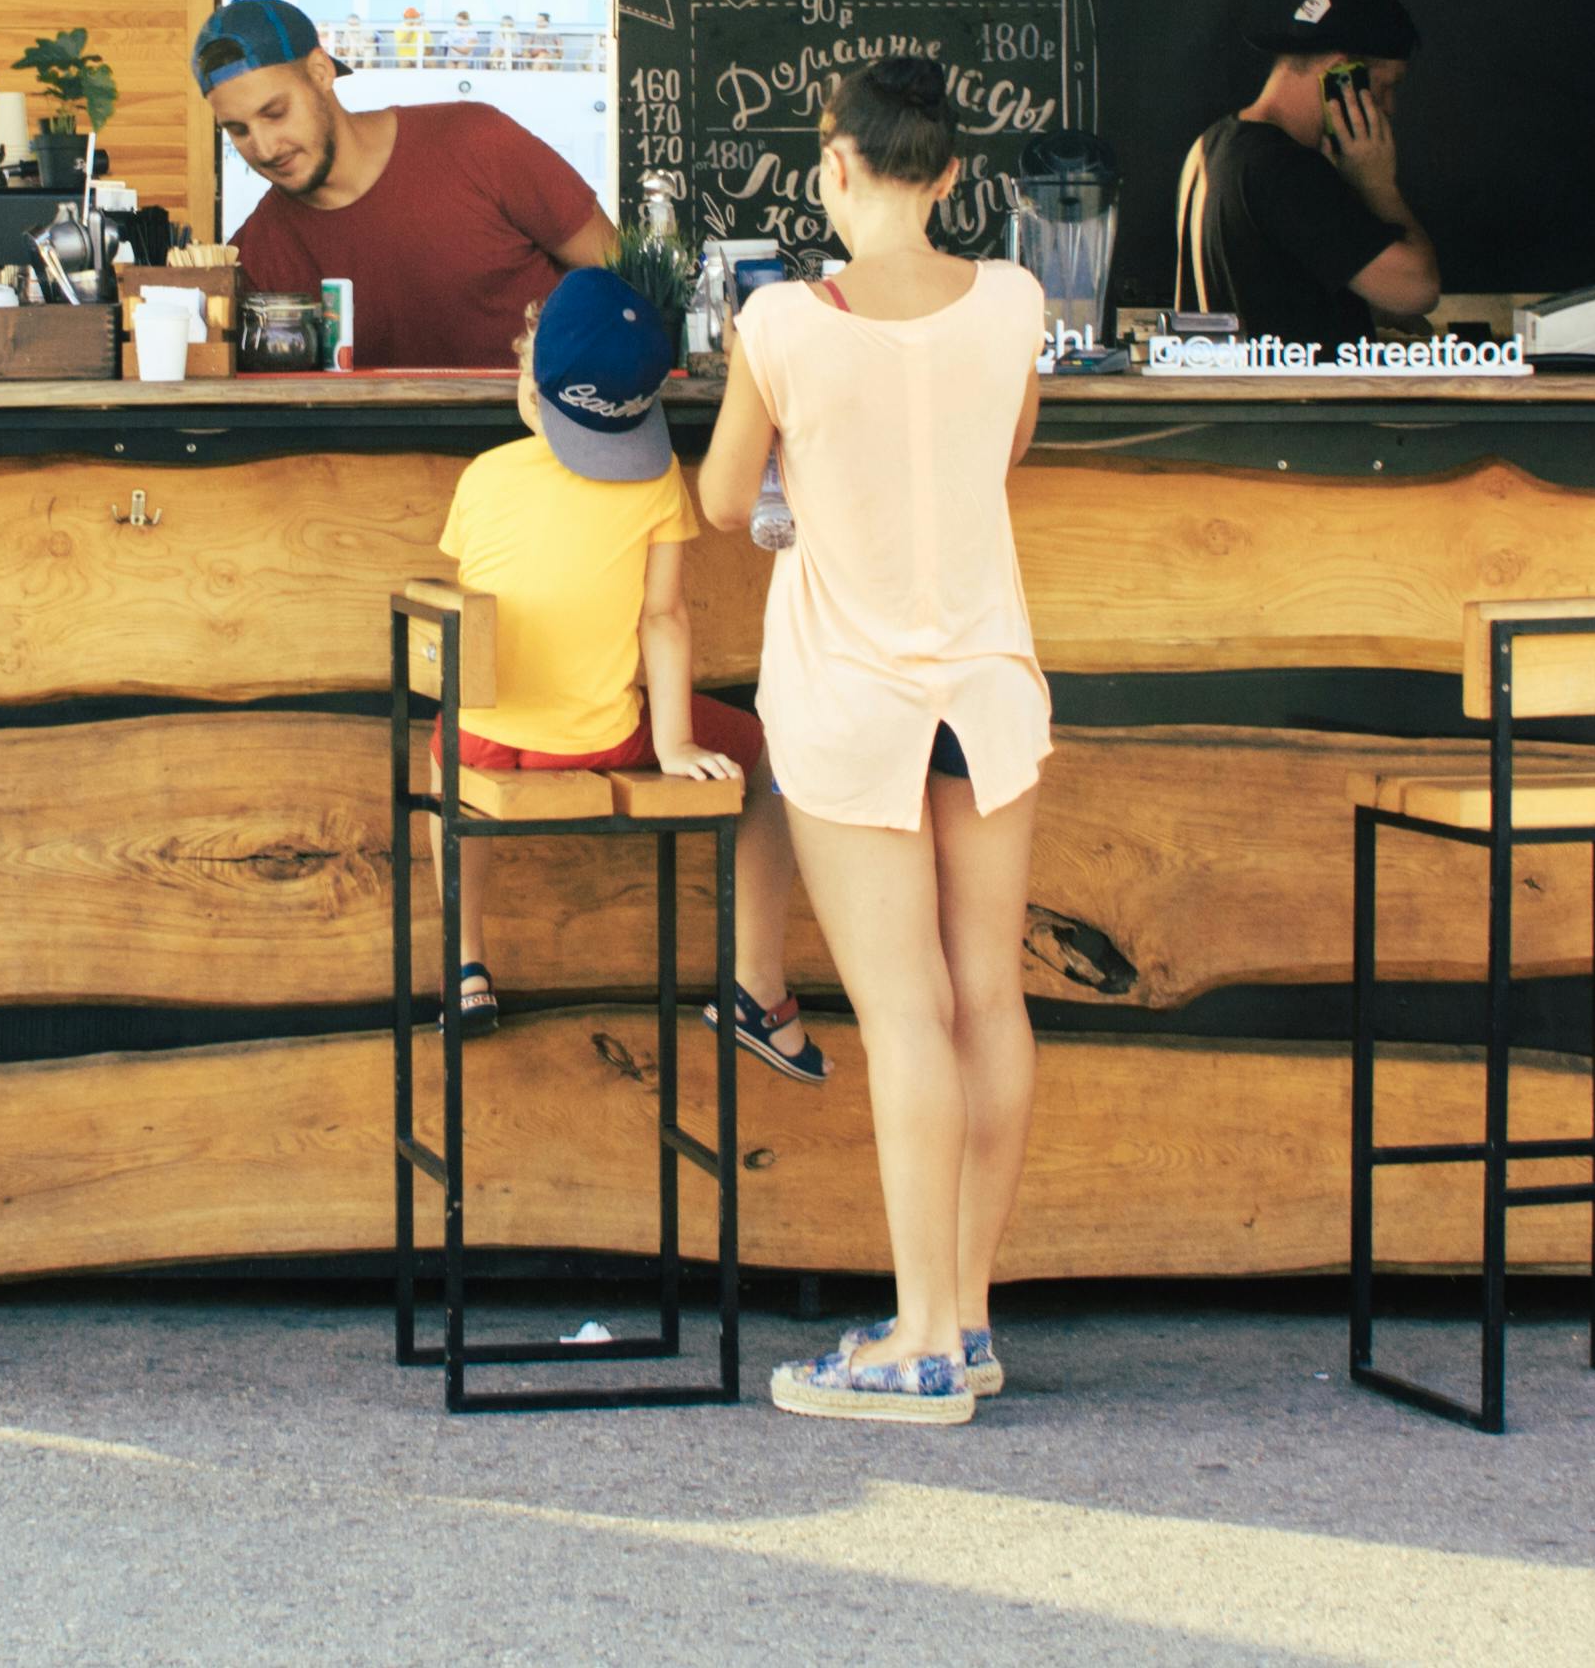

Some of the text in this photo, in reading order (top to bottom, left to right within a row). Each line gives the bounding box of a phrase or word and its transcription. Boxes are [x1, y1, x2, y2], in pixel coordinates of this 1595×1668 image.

[629, 67, 681, 103] 160
[715, 32, 942, 131] Домашние
[634, 103, 682, 134] 170
[636, 134, 684, 166] 170
